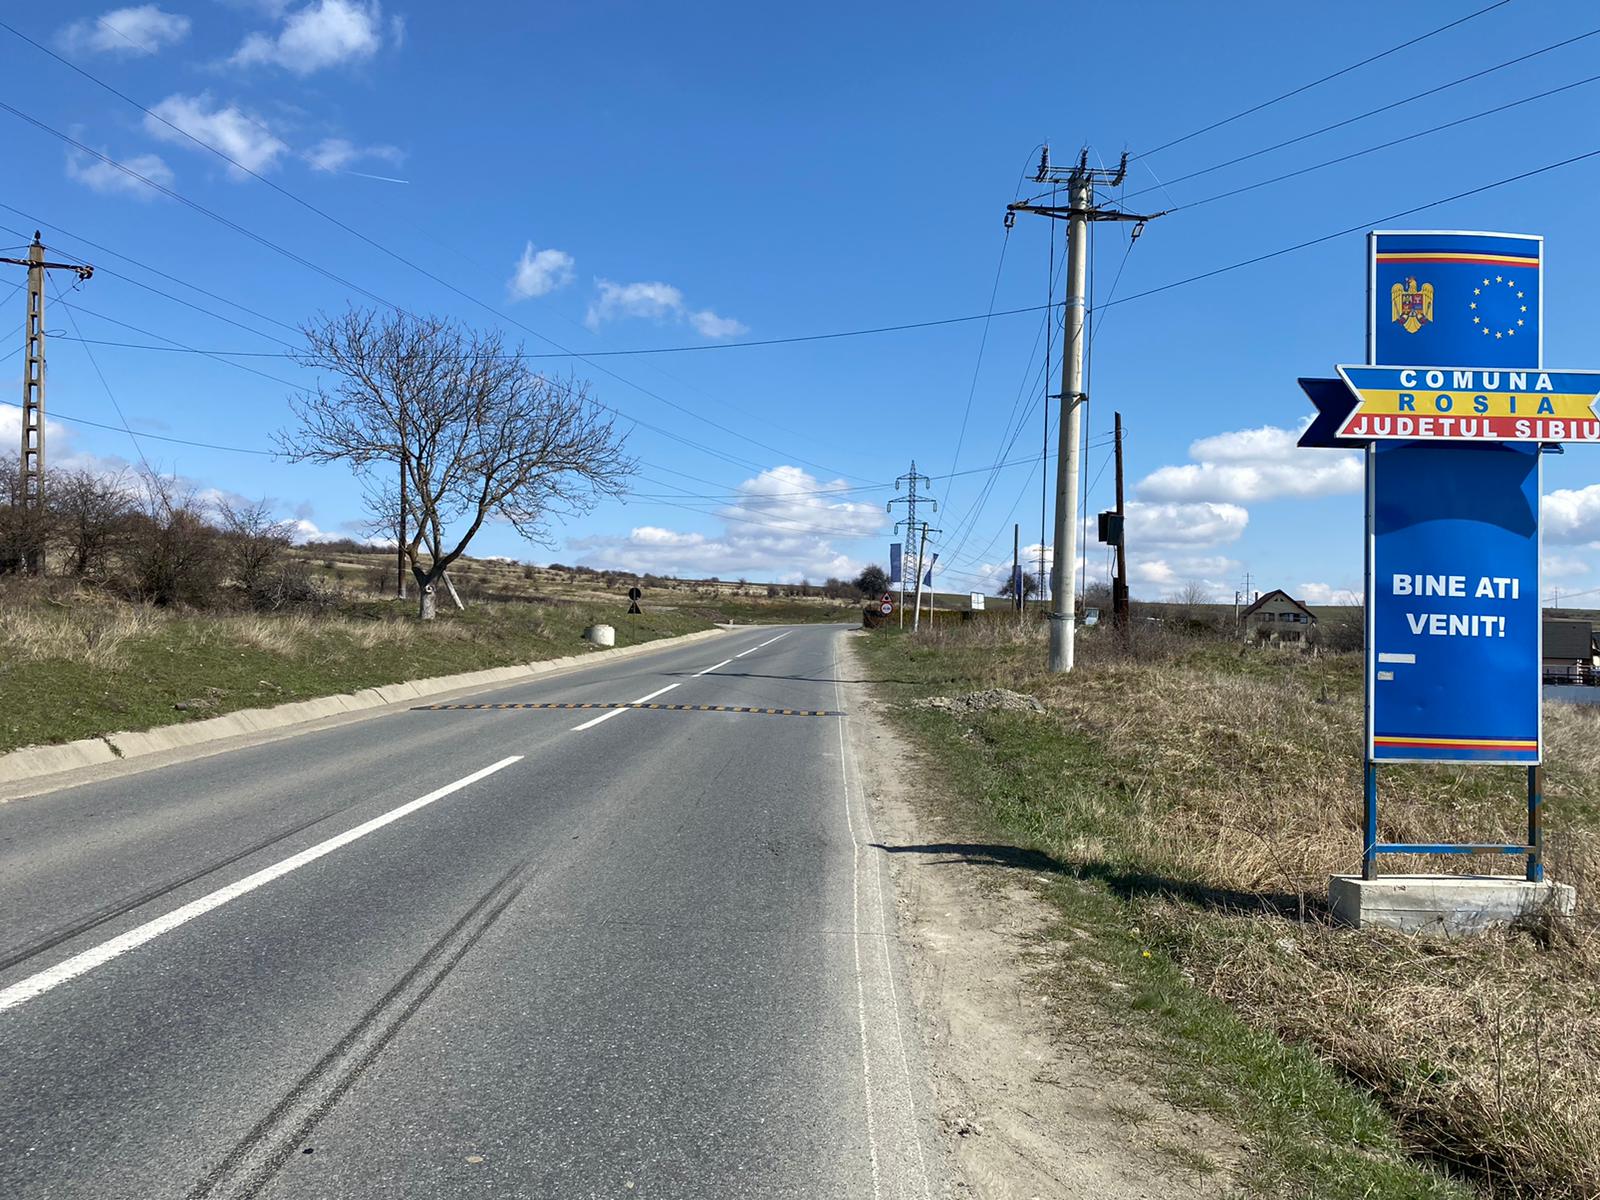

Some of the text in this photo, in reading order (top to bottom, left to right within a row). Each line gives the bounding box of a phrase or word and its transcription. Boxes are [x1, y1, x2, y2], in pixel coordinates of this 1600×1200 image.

[1400, 370, 1553, 391] COMUNA
[1353, 416, 1600, 440] JUDETUL SIBIU
[1392, 574, 1519, 599] BINE ATI
[1406, 613, 1505, 638] VENIT!
